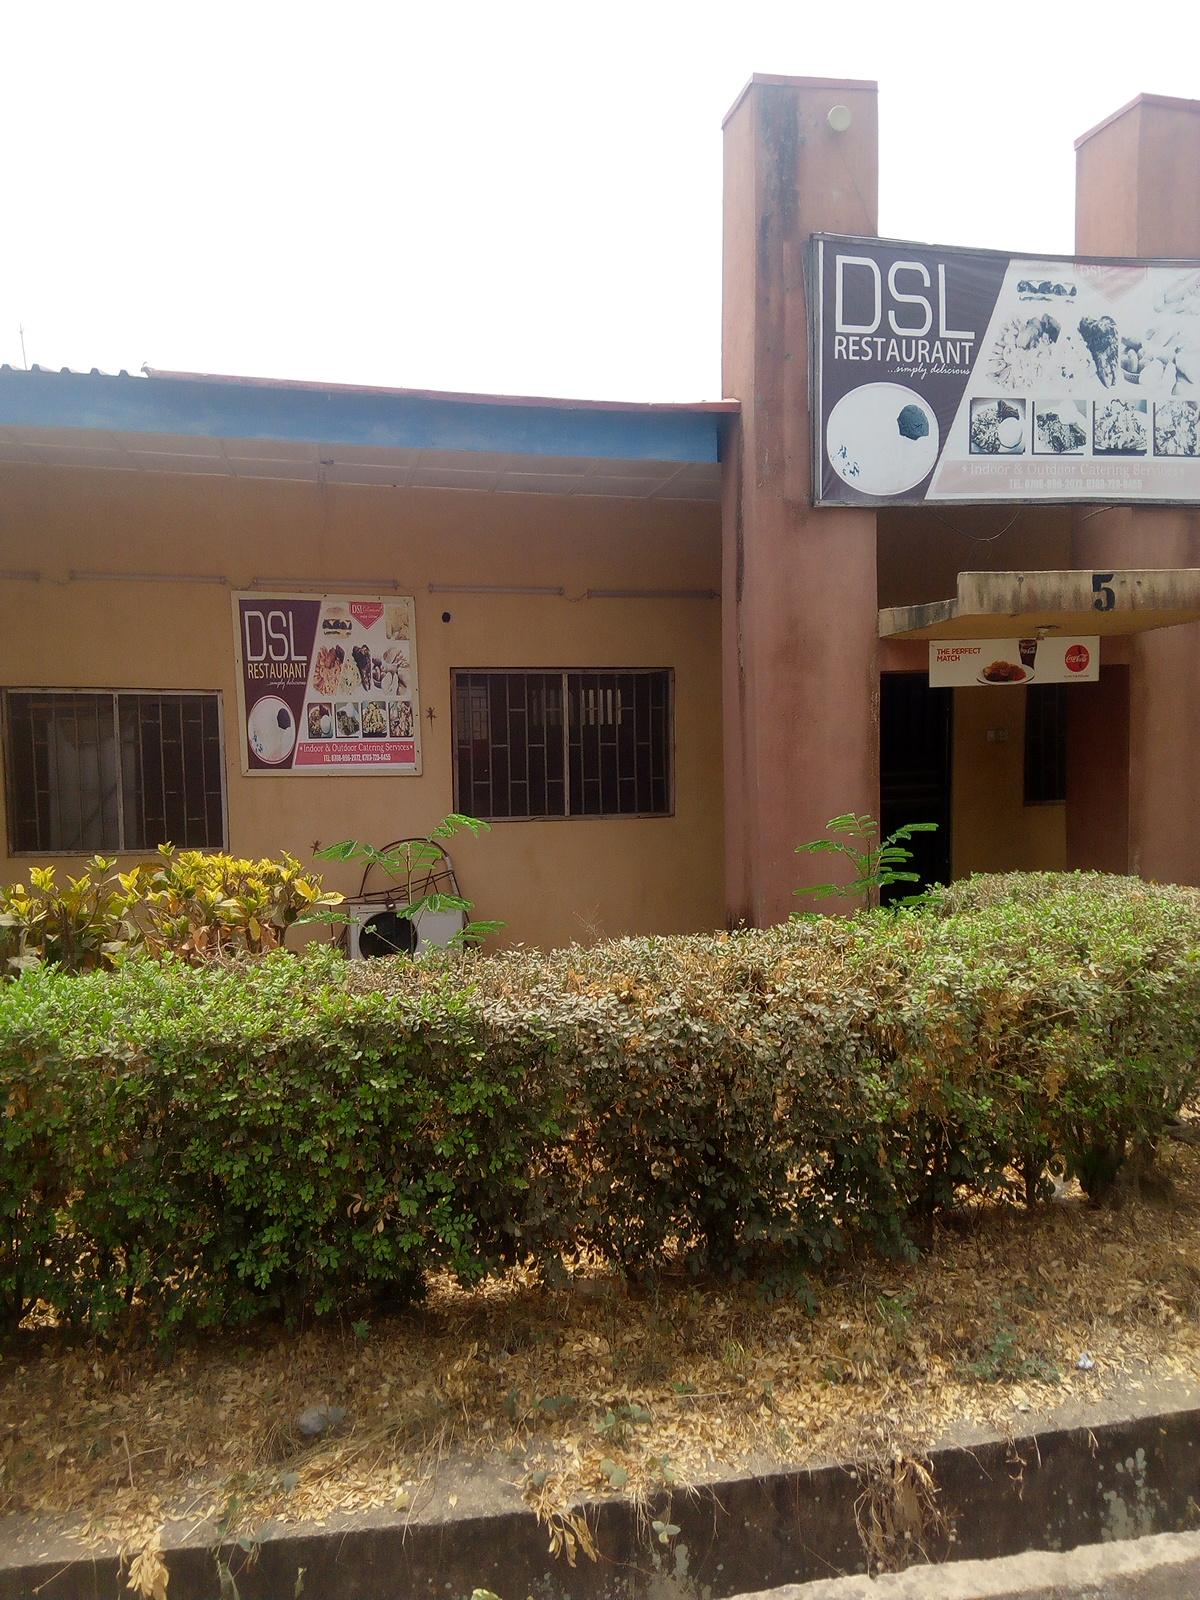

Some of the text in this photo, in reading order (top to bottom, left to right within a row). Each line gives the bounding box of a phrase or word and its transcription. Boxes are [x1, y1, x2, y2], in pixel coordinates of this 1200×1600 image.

[835, 254, 975, 340] DSL
[834, 335, 974, 365] RESTAURANT
[930, 363, 971, 375] delicious
[1092, 573, 1116, 612] 5
[244, 610, 307, 661] DSL
[952, 647, 981, 655] PERFECT
[248, 662, 307, 679] RESTAURANT
[303, 742, 410, 754] Indoor & Outdoor Catering Services
